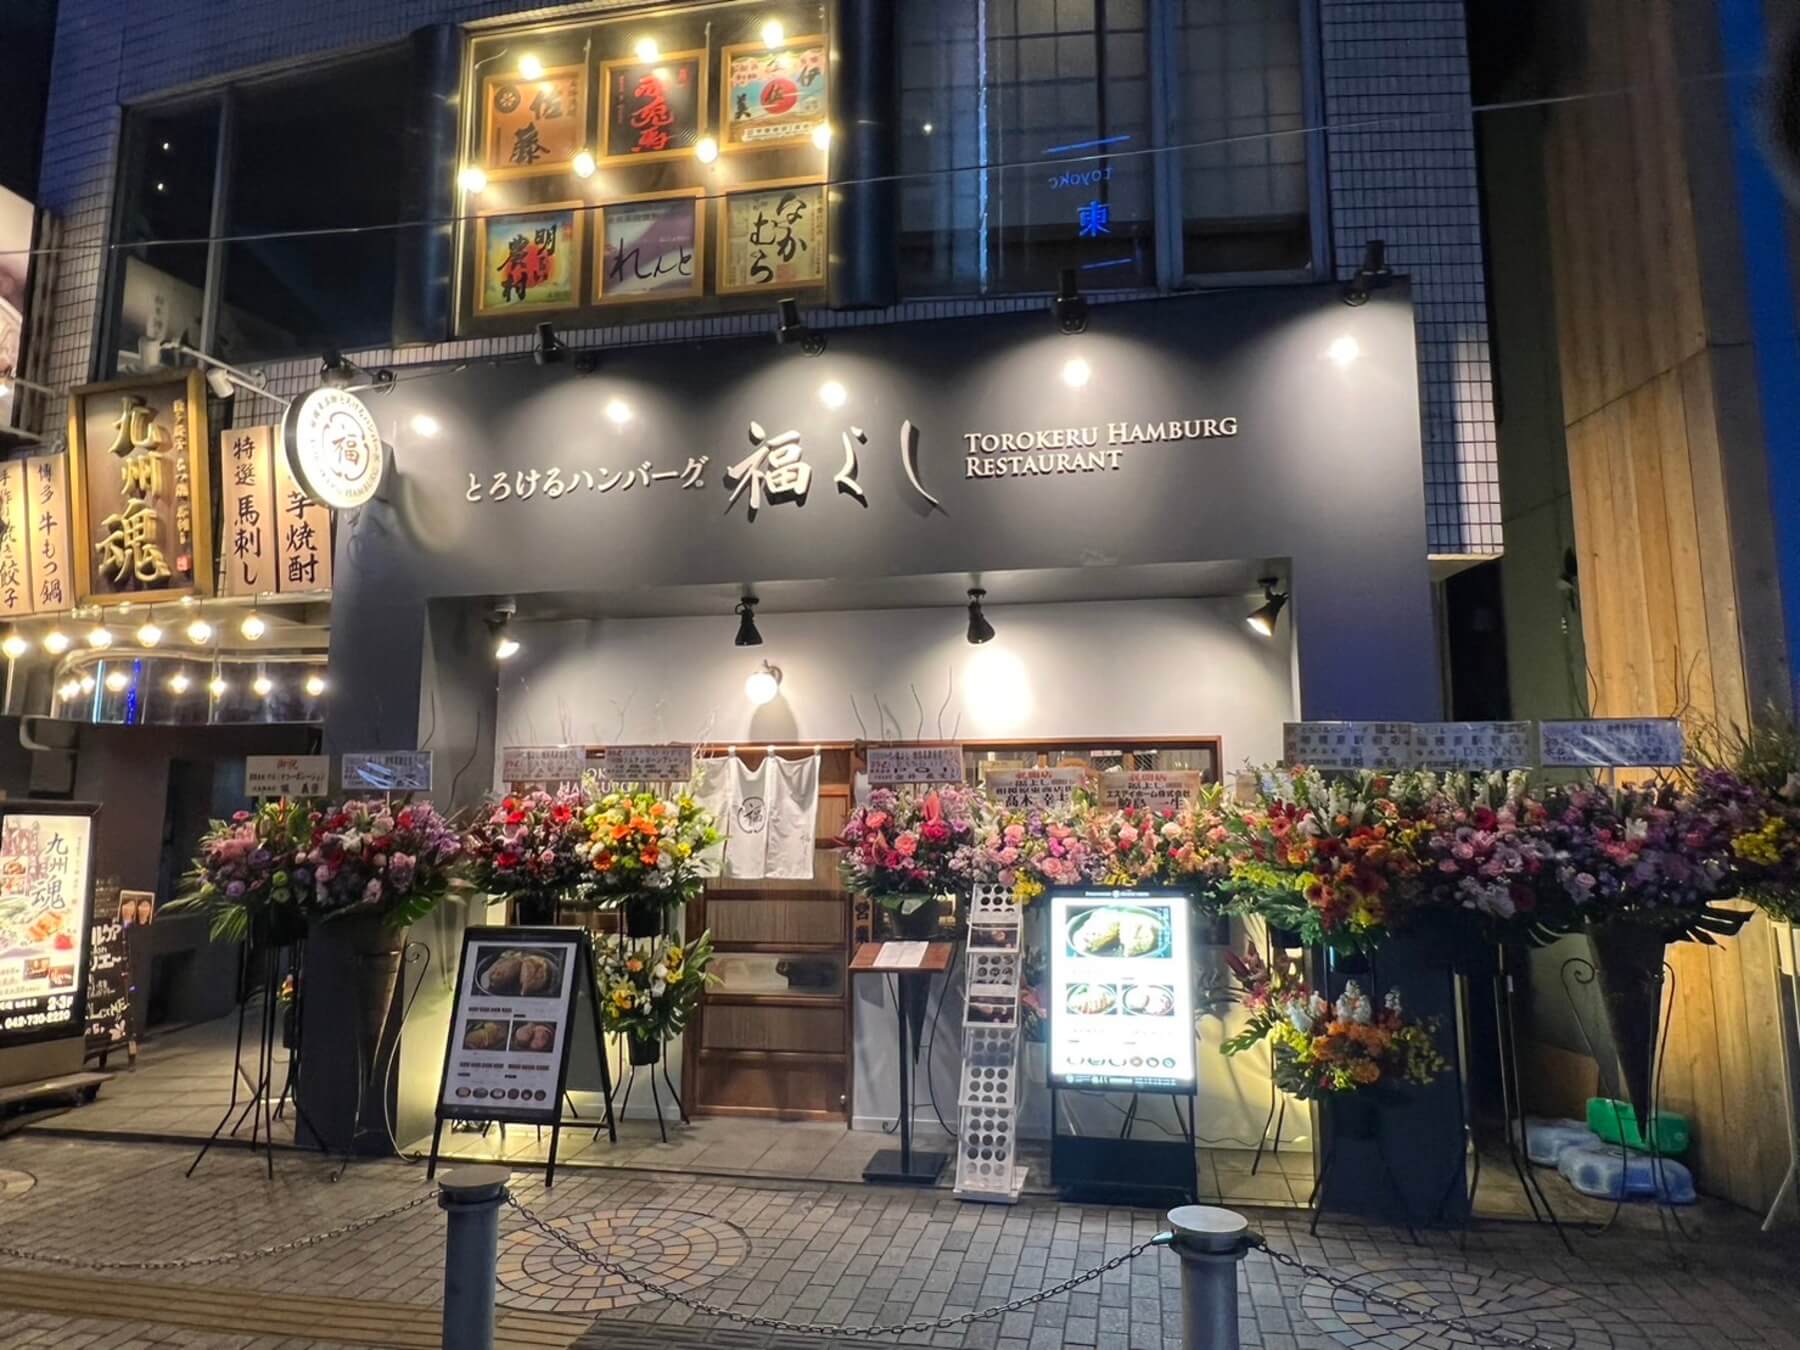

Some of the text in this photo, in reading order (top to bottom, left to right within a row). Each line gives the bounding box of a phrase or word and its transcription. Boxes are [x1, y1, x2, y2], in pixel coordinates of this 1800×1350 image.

[609, 237, 692, 282] れんと
[749, 211, 777, 283] むら
[775, 192, 807, 262] なか
[964, 416, 1239, 456] TOROKERU HAMBURG
[965, 450, 1123, 479] RESTAURANT
[96, 396, 173, 584] 九州魂
[464, 455, 710, 503] とろけるハンバーグ
[233, 495, 262, 586] 馬刺し
[31, 832, 68, 910] 九州魂
